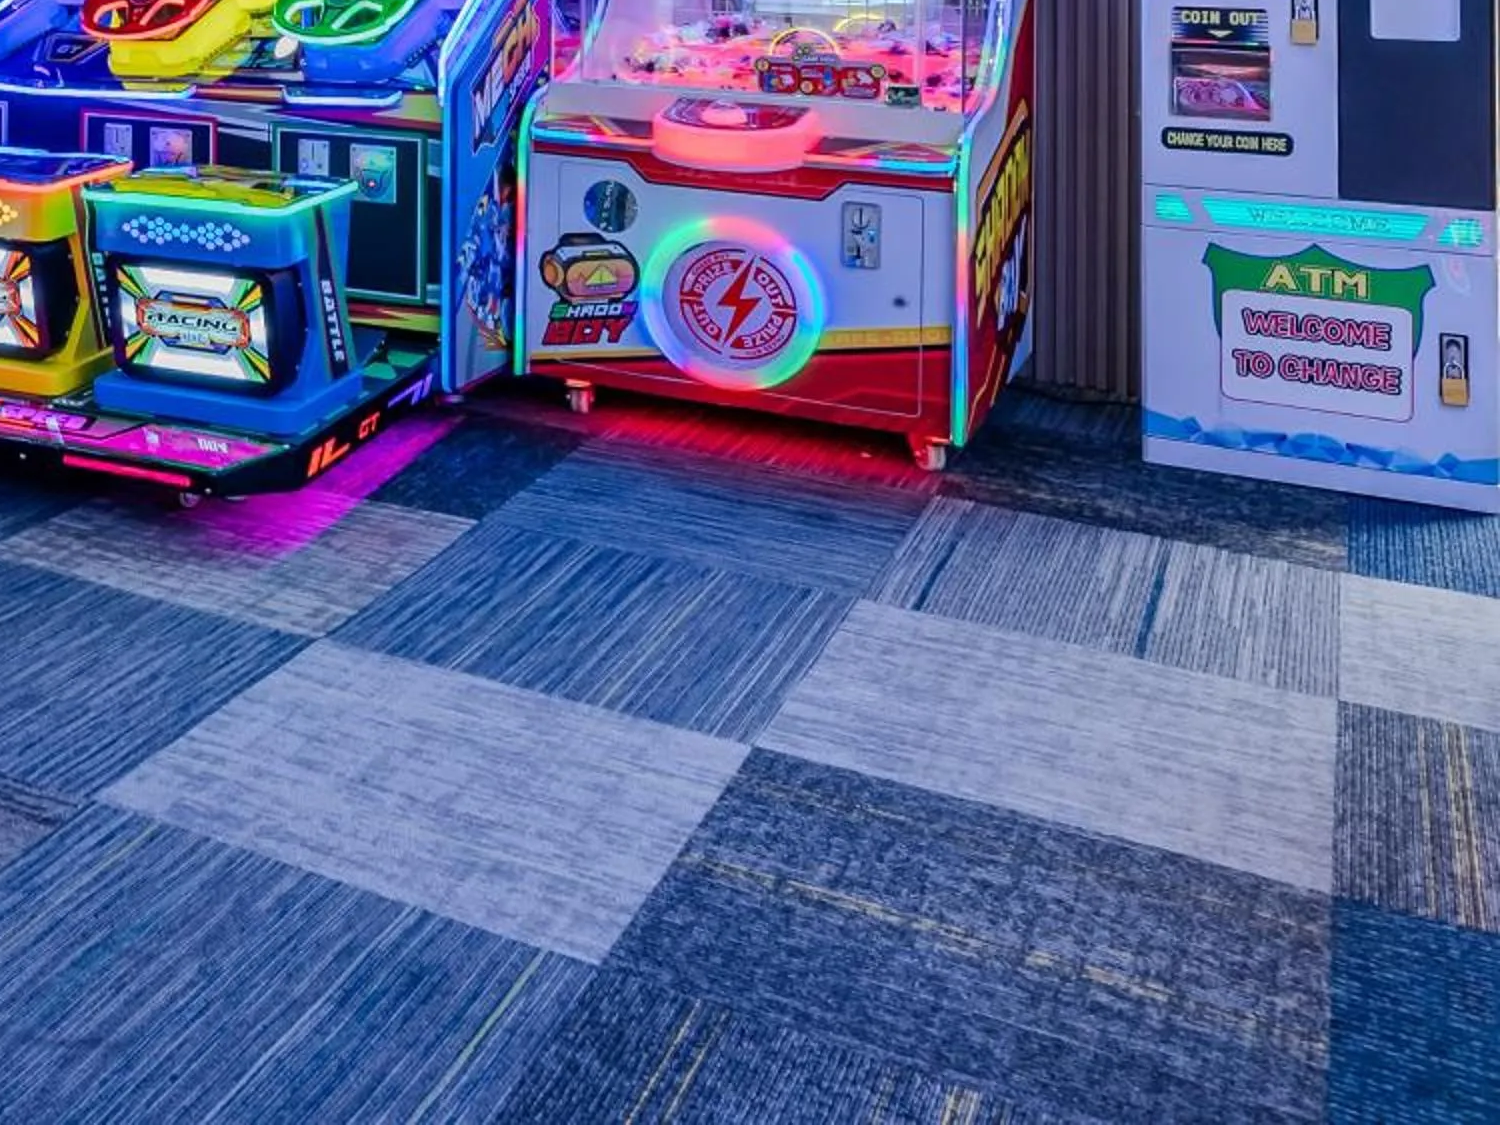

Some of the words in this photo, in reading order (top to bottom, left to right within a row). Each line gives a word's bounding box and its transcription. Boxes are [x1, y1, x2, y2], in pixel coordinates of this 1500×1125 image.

[1181, 10, 1221, 25] COIN
[1229, 11, 1260, 26] OUT
[1167, 132, 1205, 147] CHANGE
[1206, 133, 1235, 148] YOUR
[1235, 135, 1260, 150] COIN
[1261, 137, 1288, 152] HERE
[757, 271, 785, 307] OUT
[1261, 261, 1370, 301] ATM
[147, 312, 238, 332] RACING
[1242, 307, 1392, 351] WELCOME
[1233, 349, 1273, 380] TO
[1279, 355, 1404, 396] CHANGE
